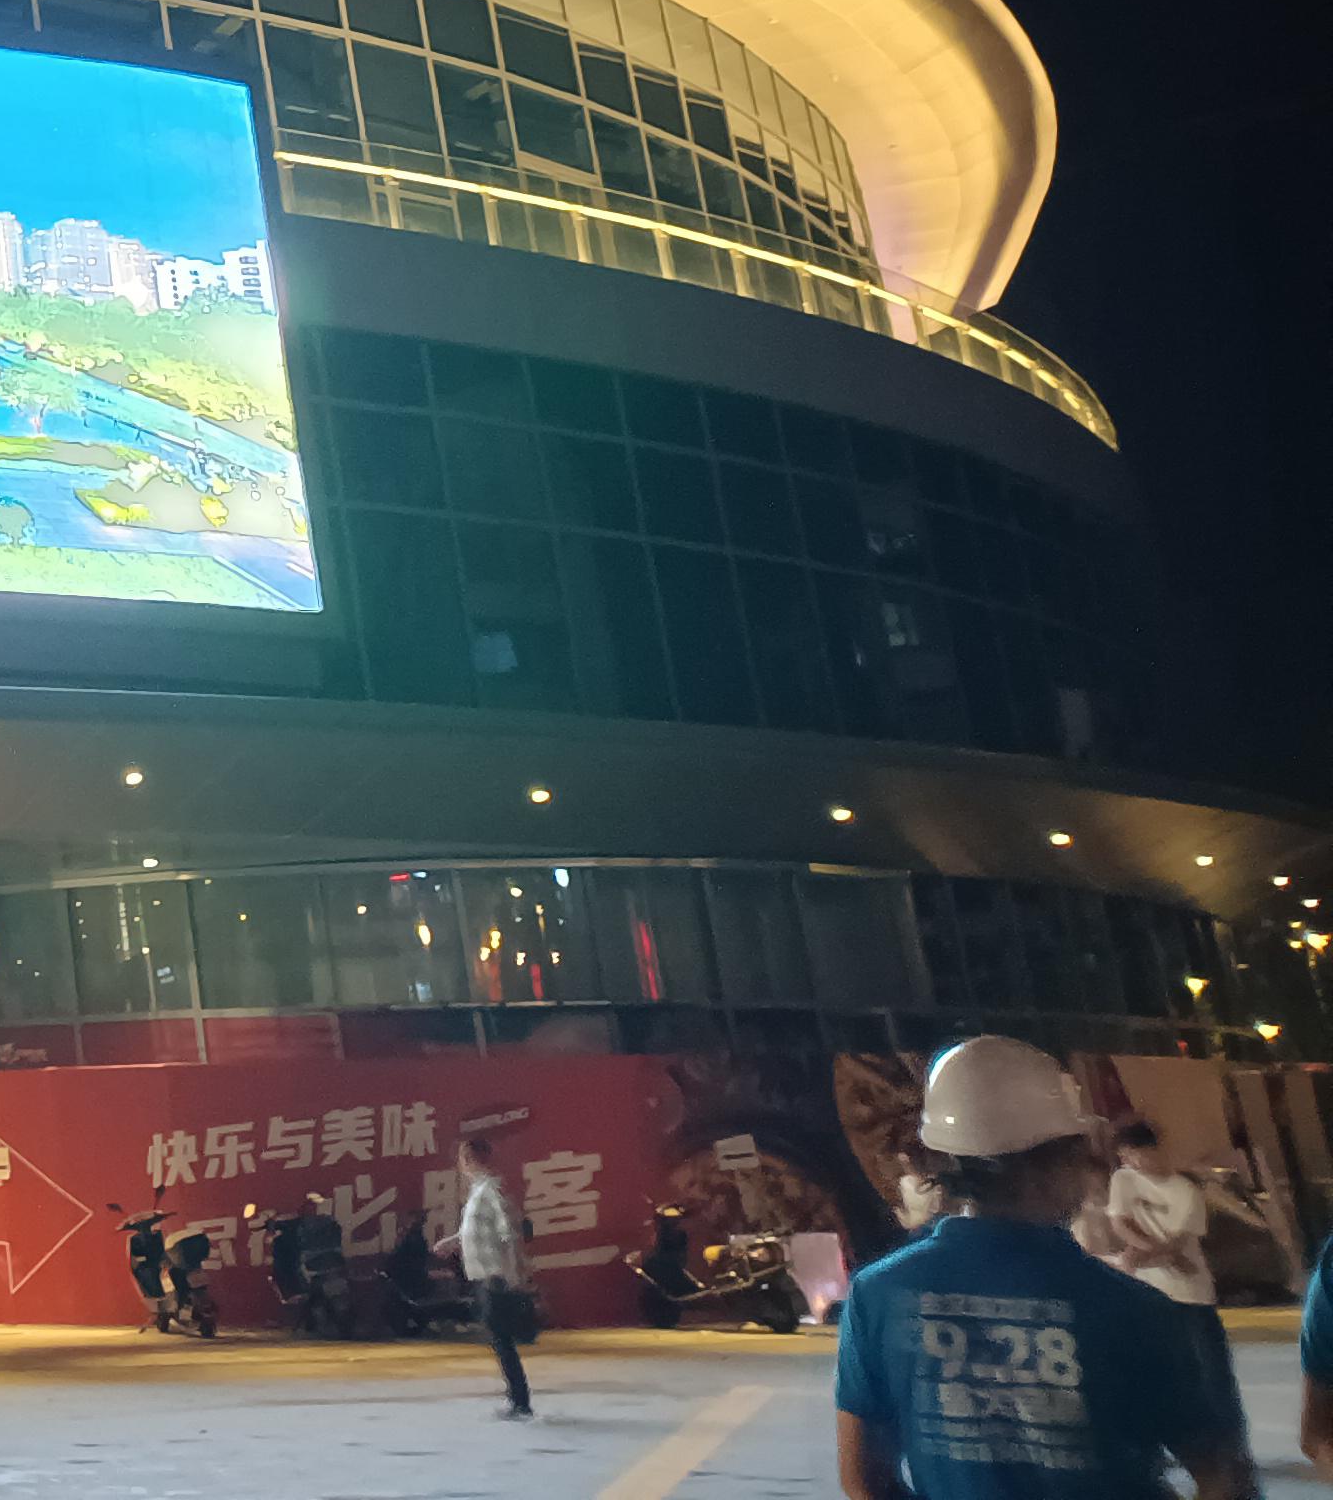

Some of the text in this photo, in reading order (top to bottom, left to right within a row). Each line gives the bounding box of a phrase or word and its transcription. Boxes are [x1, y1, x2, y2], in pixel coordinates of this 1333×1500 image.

[147, 1102, 439, 1187] 快乐与美味
